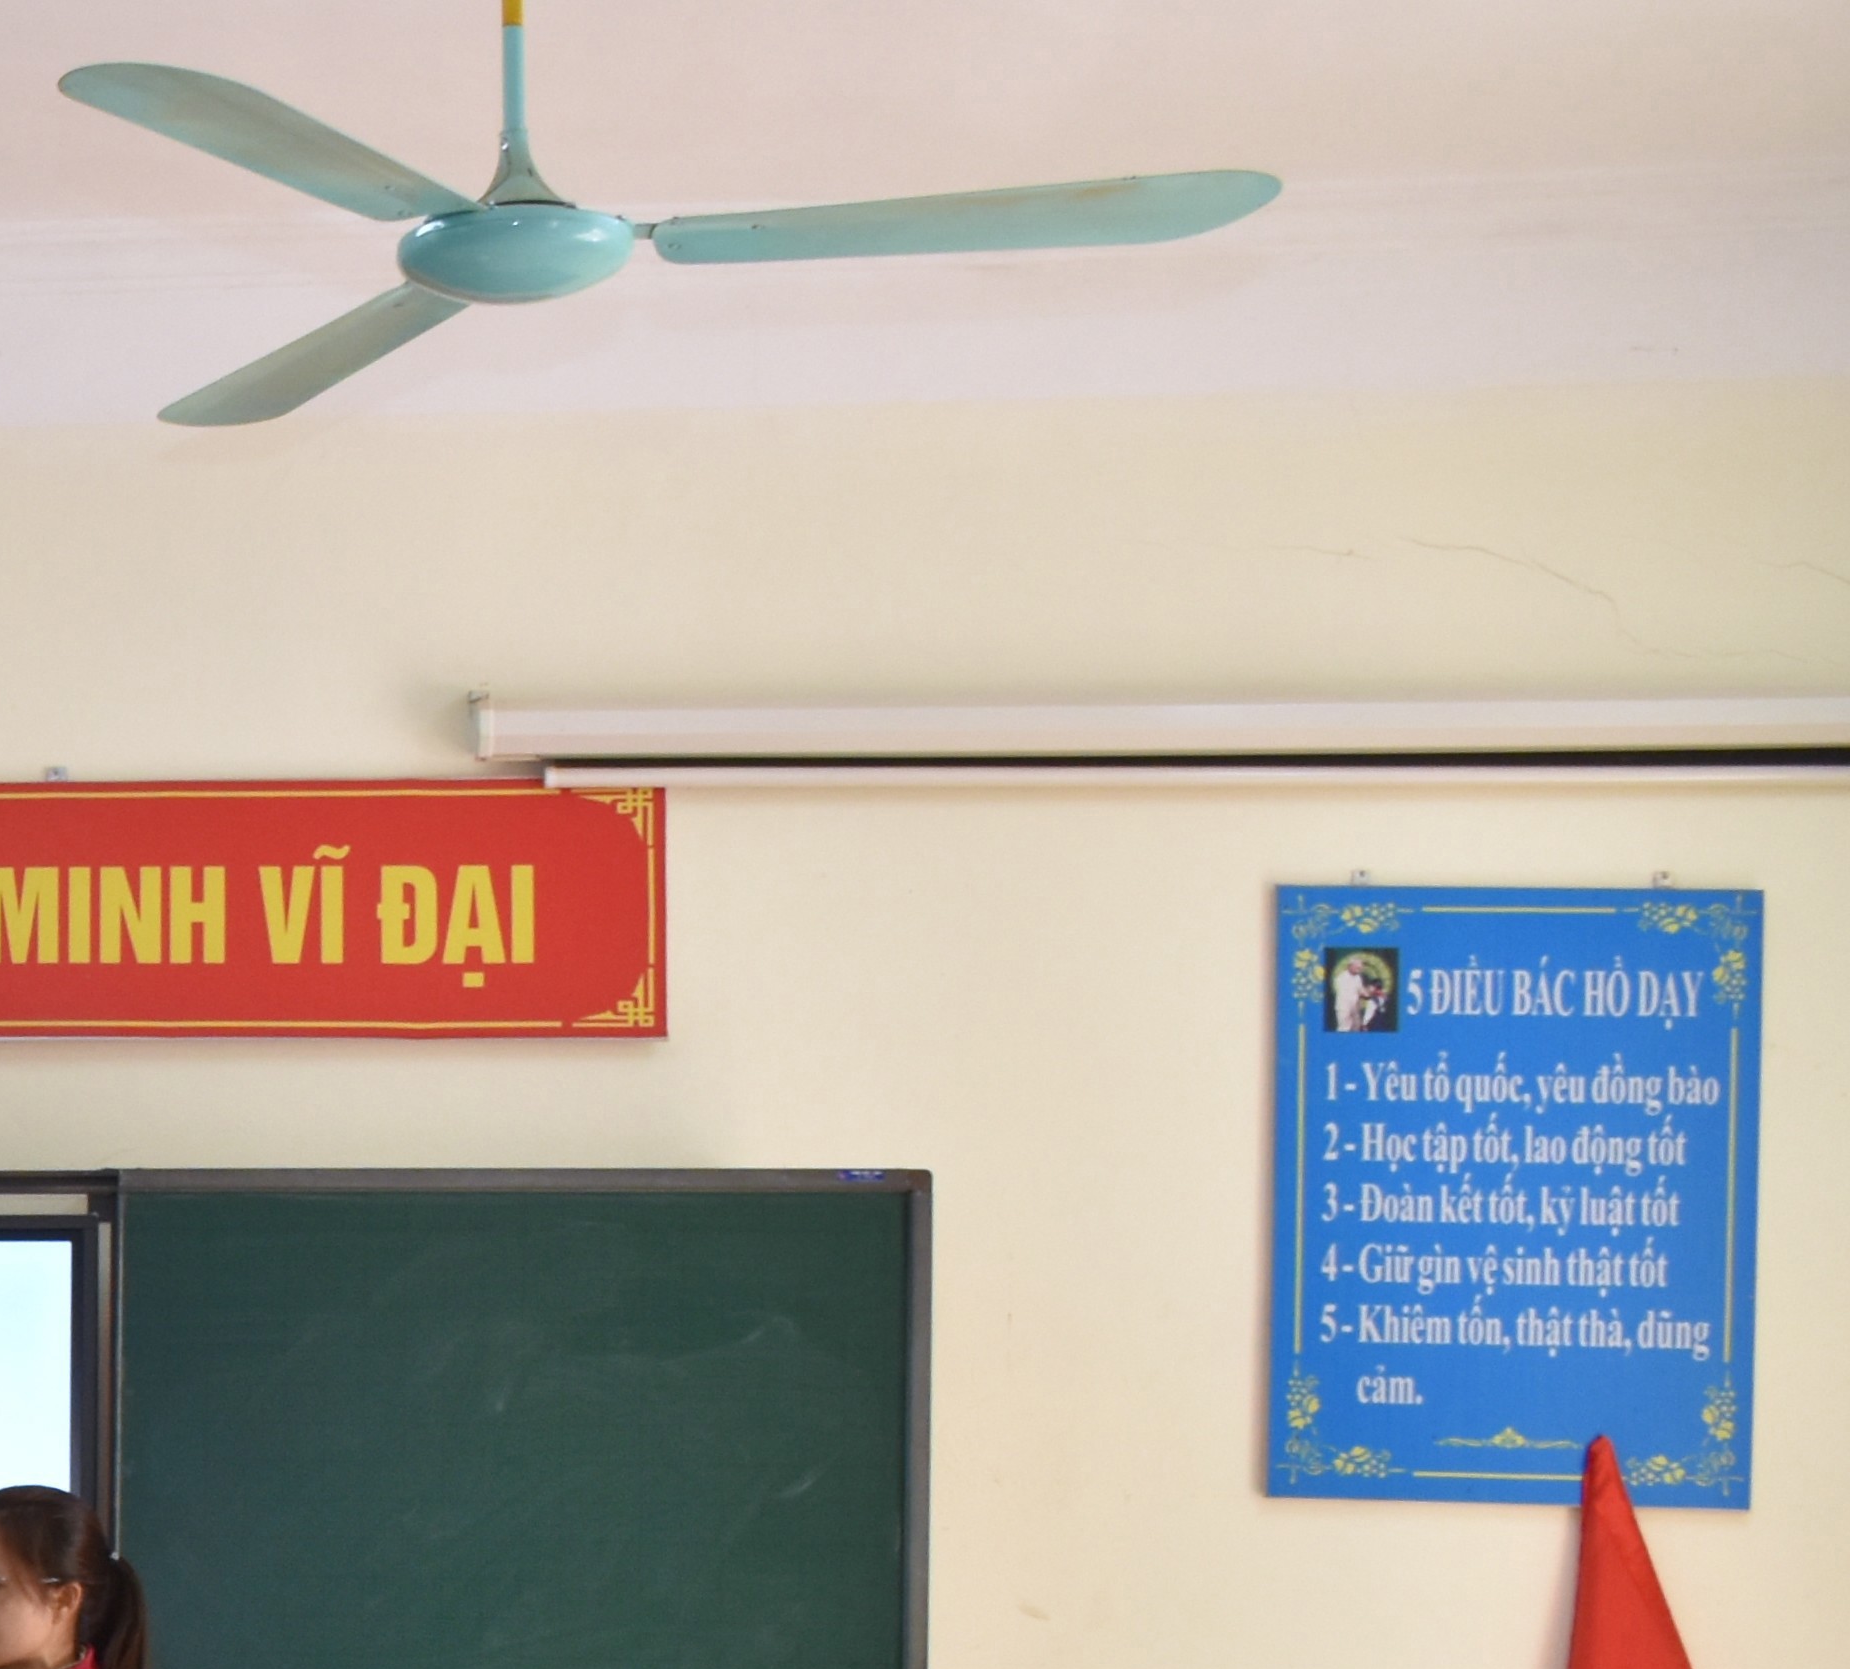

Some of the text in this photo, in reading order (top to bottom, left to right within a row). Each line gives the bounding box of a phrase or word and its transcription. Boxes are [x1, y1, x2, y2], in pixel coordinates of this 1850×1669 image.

[259, 845, 350, 964] VĨ
[377, 865, 534, 987] ĐẠI
[1407, 955, 1704, 1029] 5 ĐIỀU BÁC HỒ DẠY
[1362, 1061, 1417, 1101] Yêu
[1423, 1051, 1450, 1102] tổ
[1455, 1051, 1533, 1113] quốc,
[1535, 1062, 1585, 1114] yêu
[1591, 1052, 1663, 1116] đồng
[1667, 1065, 1720, 1105] bào
[1361, 1122, 1417, 1172] Học
[1422, 1122, 1467, 1174] tập
[1473, 1111, 1519, 1172] tốt,
[1525, 1126, 1566, 1164] lao
[1572, 1124, 1642, 1176] động
[1647, 1114, 1686, 1166] tốt
[1360, 1183, 1433, 1223] Đoàn
[1440, 1173, 1483, 1223] kết
[1488, 1173, 1536, 1232] tốt,
[1580, 1186, 1635, 1236] luật
[1641, 1175, 1680, 1227] tốt
[1358, 1243, 1415, 1284] Giữ
[1417, 1243, 1461, 1295] gìn
[1467, 1244, 1498, 1296] vệ
[1502, 1247, 1560, 1286] sinh
[1566, 1247, 1624, 1297] thật
[1629, 1237, 1668, 1288] tốt
[1358, 1304, 1451, 1344] Khiêm
[1458, 1294, 1511, 1354] tốn,
[1516, 1307, 1573, 1357] thật
[1578, 1308, 1632, 1356] thà,
[1637, 1310, 1710, 1360] dũng
[1356, 1365, 1424, 1405] cảm.
